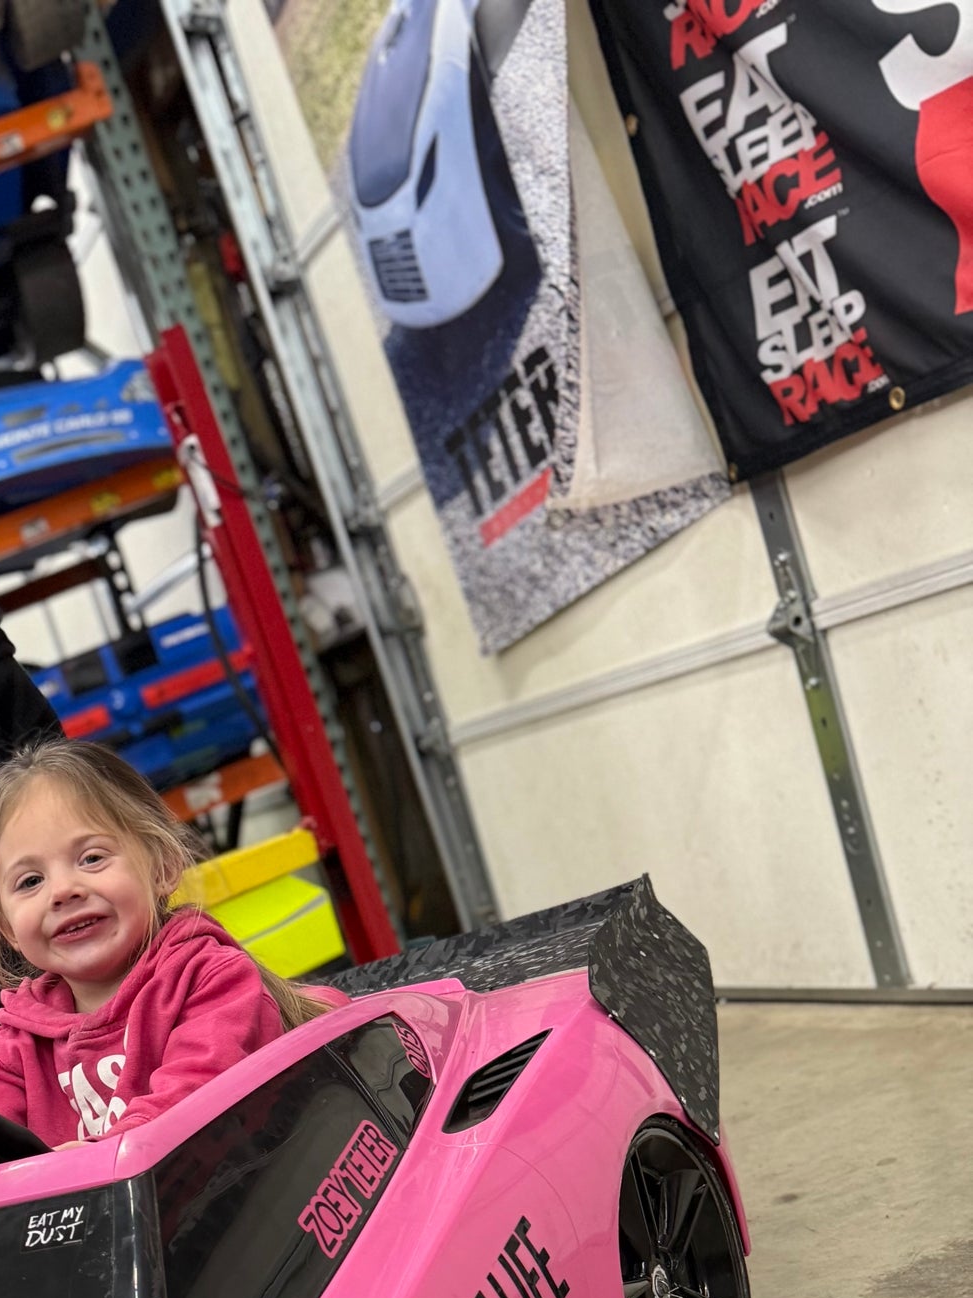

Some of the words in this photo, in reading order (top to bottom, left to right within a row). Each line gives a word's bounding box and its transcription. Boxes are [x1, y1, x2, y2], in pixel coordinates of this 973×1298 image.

[670, 0, 767, 71] RC
[679, 22, 793, 152] EAT
[757, 290, 866, 384] SLEP
[28, 1210, 61, 1229] EAT
[60, 1205, 84, 1223] MY
[299, 1170, 362, 1258] ZOEY
[337, 1121, 397, 1198] TETER
[25, 1220, 84, 1247] DUST
